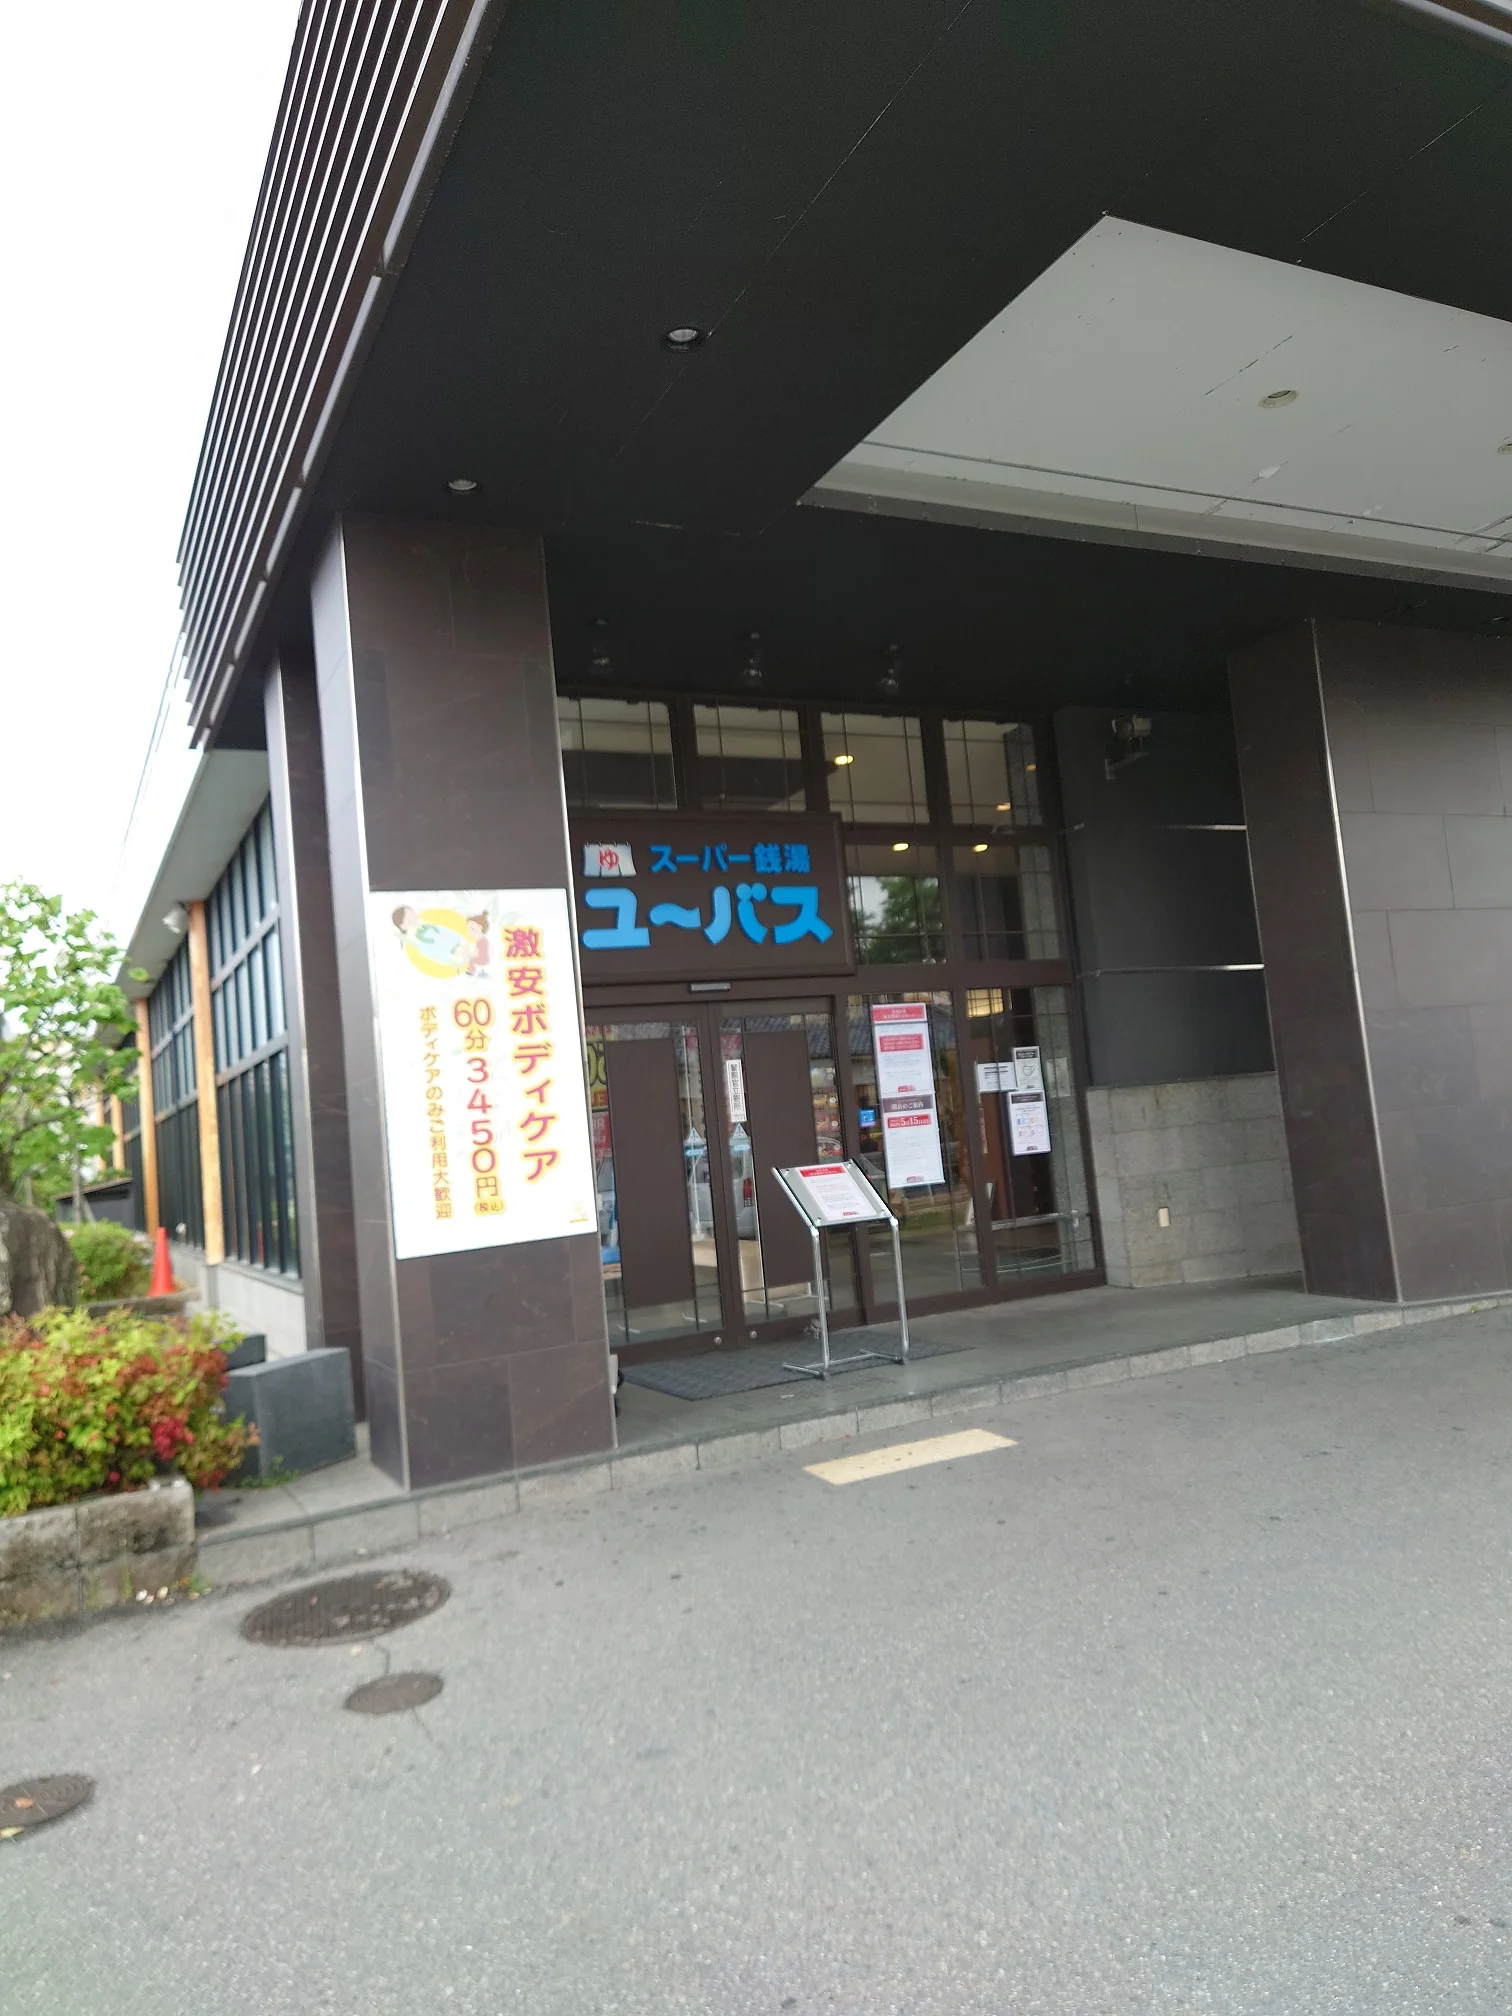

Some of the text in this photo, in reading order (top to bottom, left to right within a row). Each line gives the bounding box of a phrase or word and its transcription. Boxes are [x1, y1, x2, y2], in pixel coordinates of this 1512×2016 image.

[599, 849, 620, 871] ゆ
[650, 842, 811, 874] スーパー銭湯
[420, 1007, 452, 1218] ボディケアのみご利用大歓迎
[504, 927, 558, 1181] 激安ボディケア
